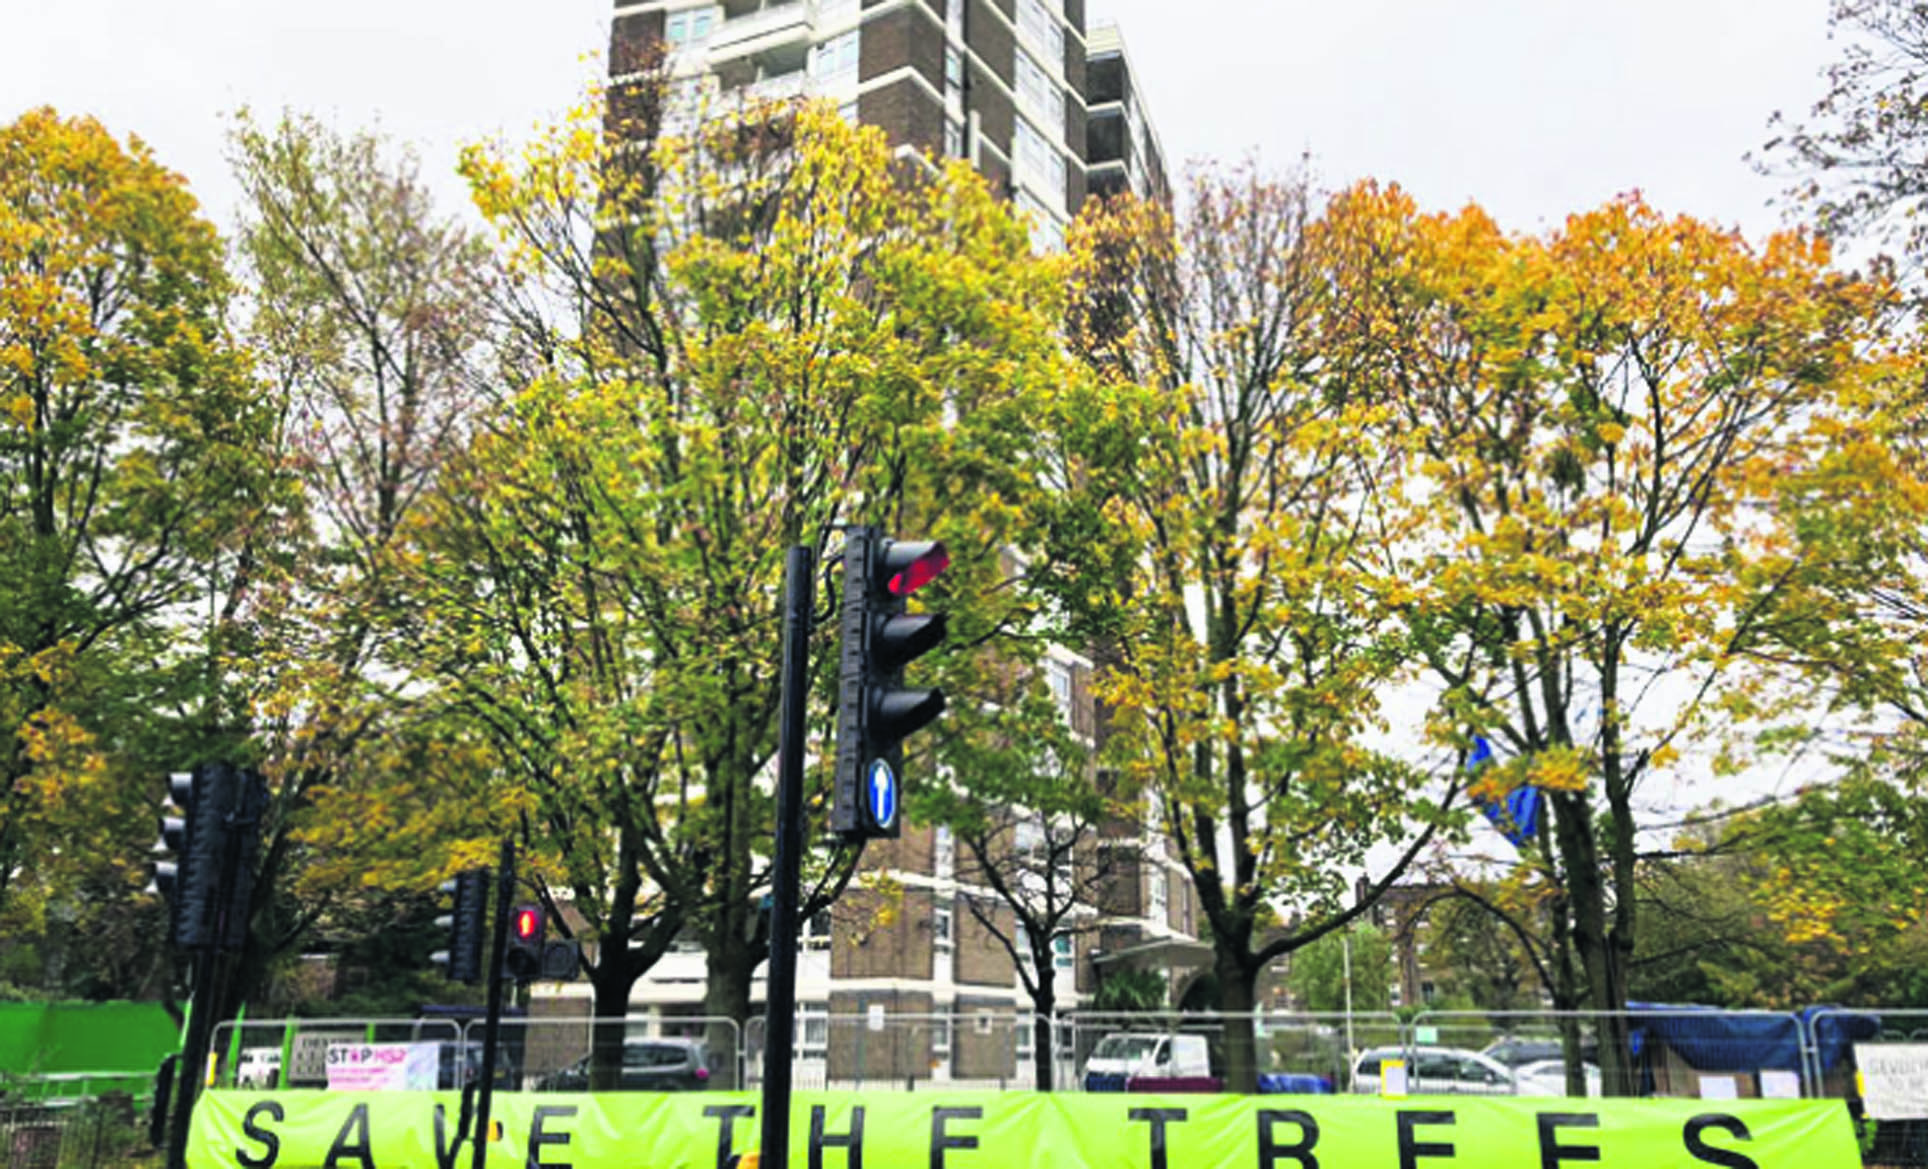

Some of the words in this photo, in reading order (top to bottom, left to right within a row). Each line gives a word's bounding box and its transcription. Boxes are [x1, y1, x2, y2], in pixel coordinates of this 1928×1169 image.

[236, 1100, 578, 1169] SAVE
[702, 1104, 983, 1169] THE
[1128, 1107, 1759, 1169] TREES
